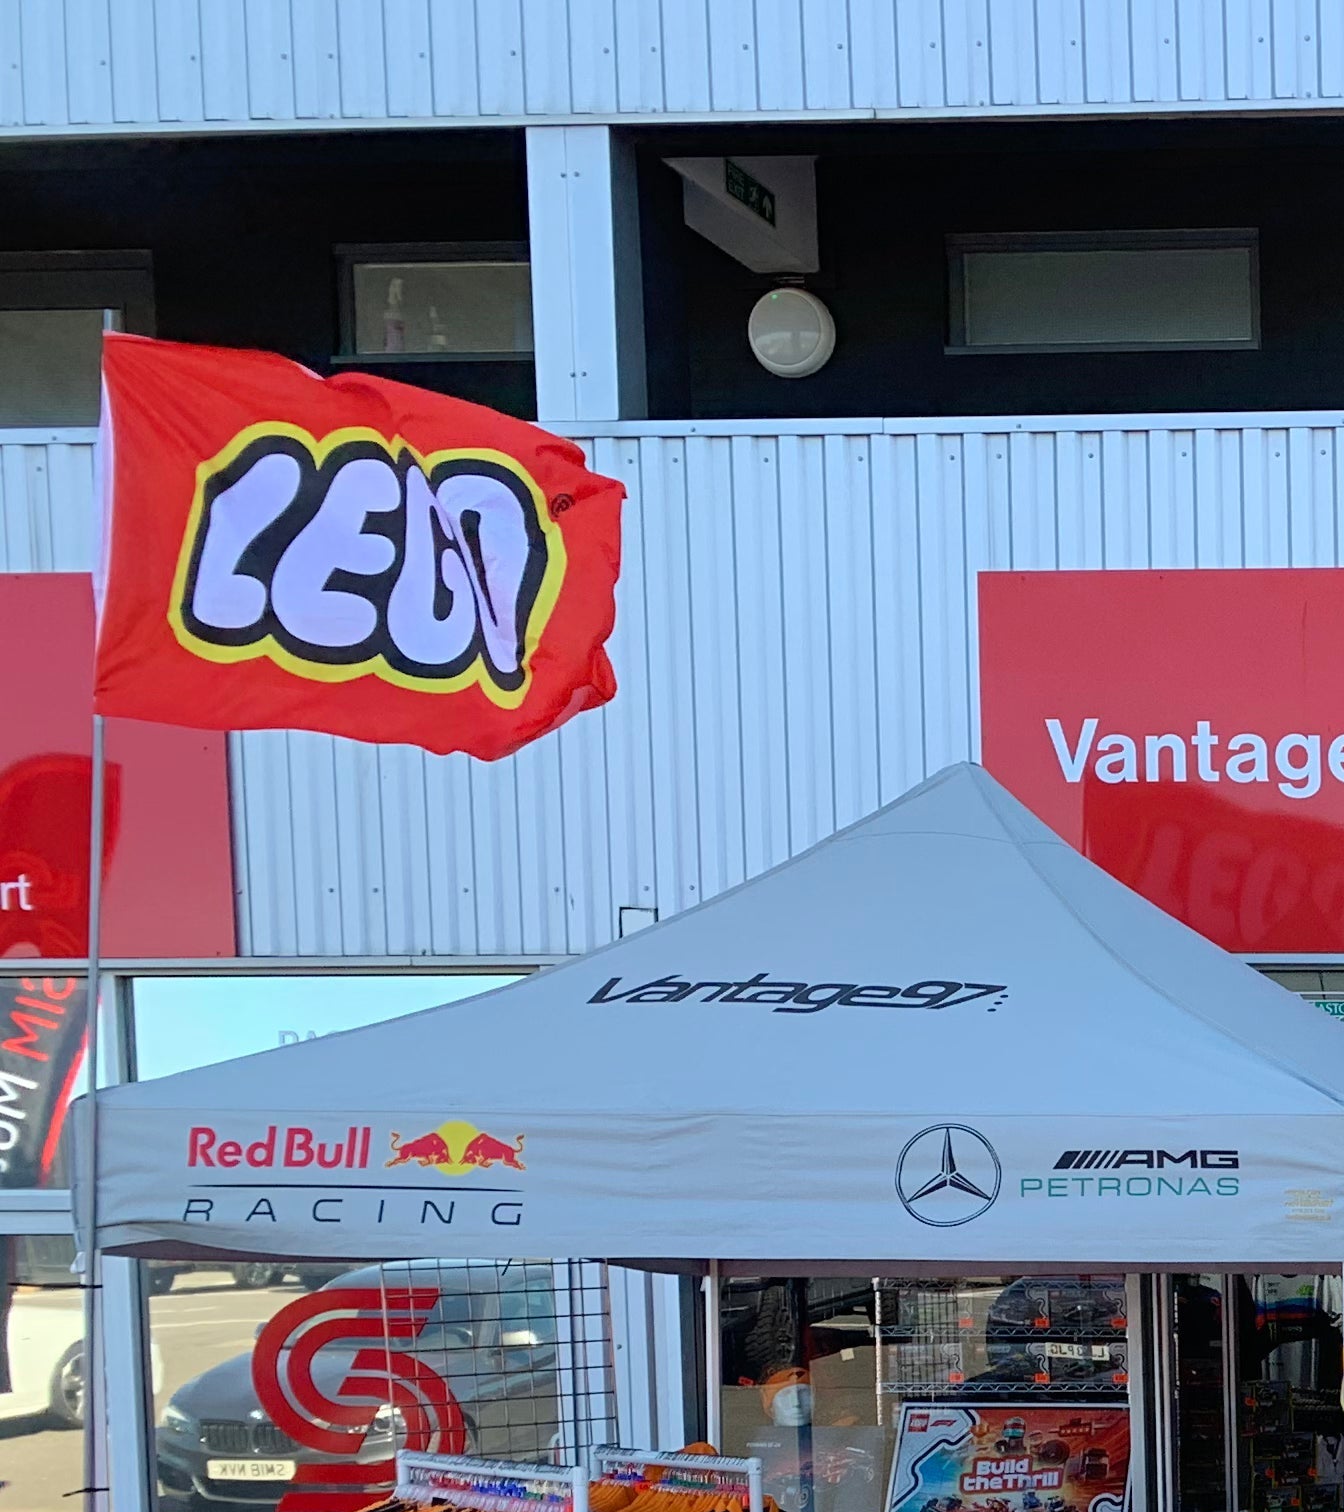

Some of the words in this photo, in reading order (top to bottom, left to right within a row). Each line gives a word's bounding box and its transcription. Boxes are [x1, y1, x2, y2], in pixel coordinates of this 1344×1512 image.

[181, 434, 550, 692] LEGO
[586, 972, 1008, 1014] Vantage97
[187, 1126, 277, 1170] Red
[283, 1126, 372, 1170] Bull
[1020, 1177, 1240, 1198] PETRONAS
[181, 1198, 524, 1227] RACING
[976, 1458, 1029, 1475] Build
